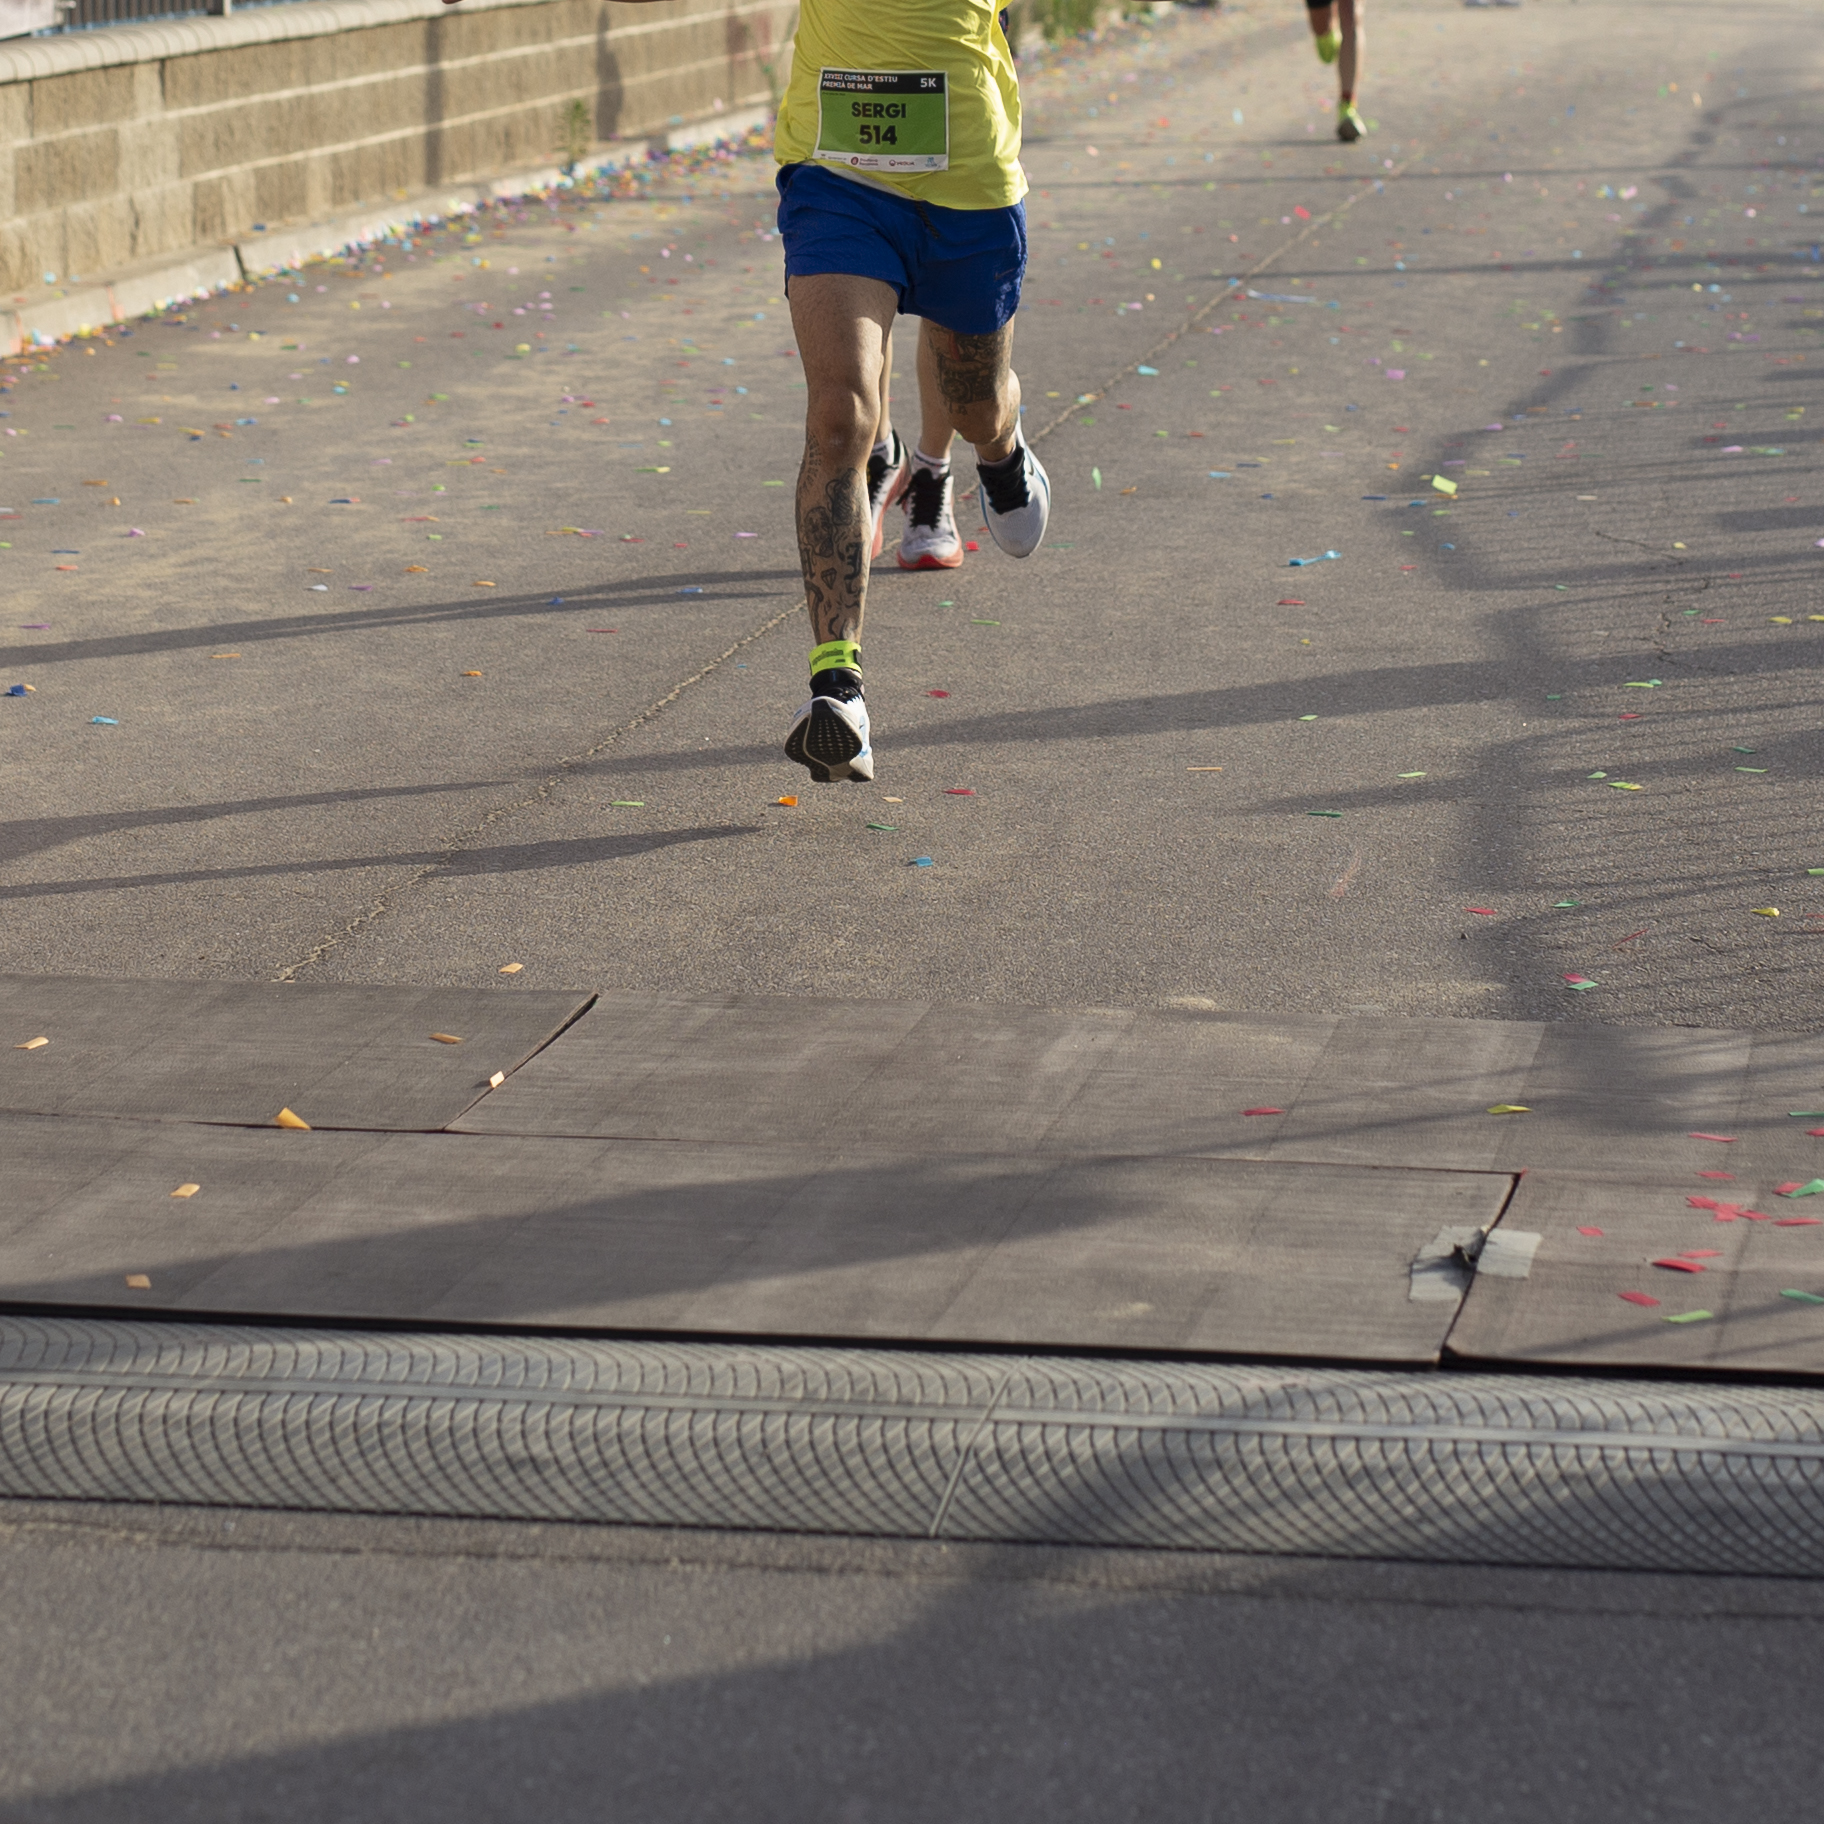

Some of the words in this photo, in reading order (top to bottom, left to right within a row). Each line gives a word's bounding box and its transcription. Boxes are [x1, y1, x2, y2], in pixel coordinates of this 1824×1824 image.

[919, 77, 937, 88] 5K
[851, 101, 907, 119] SERGI
[859, 123, 898, 145] 514
